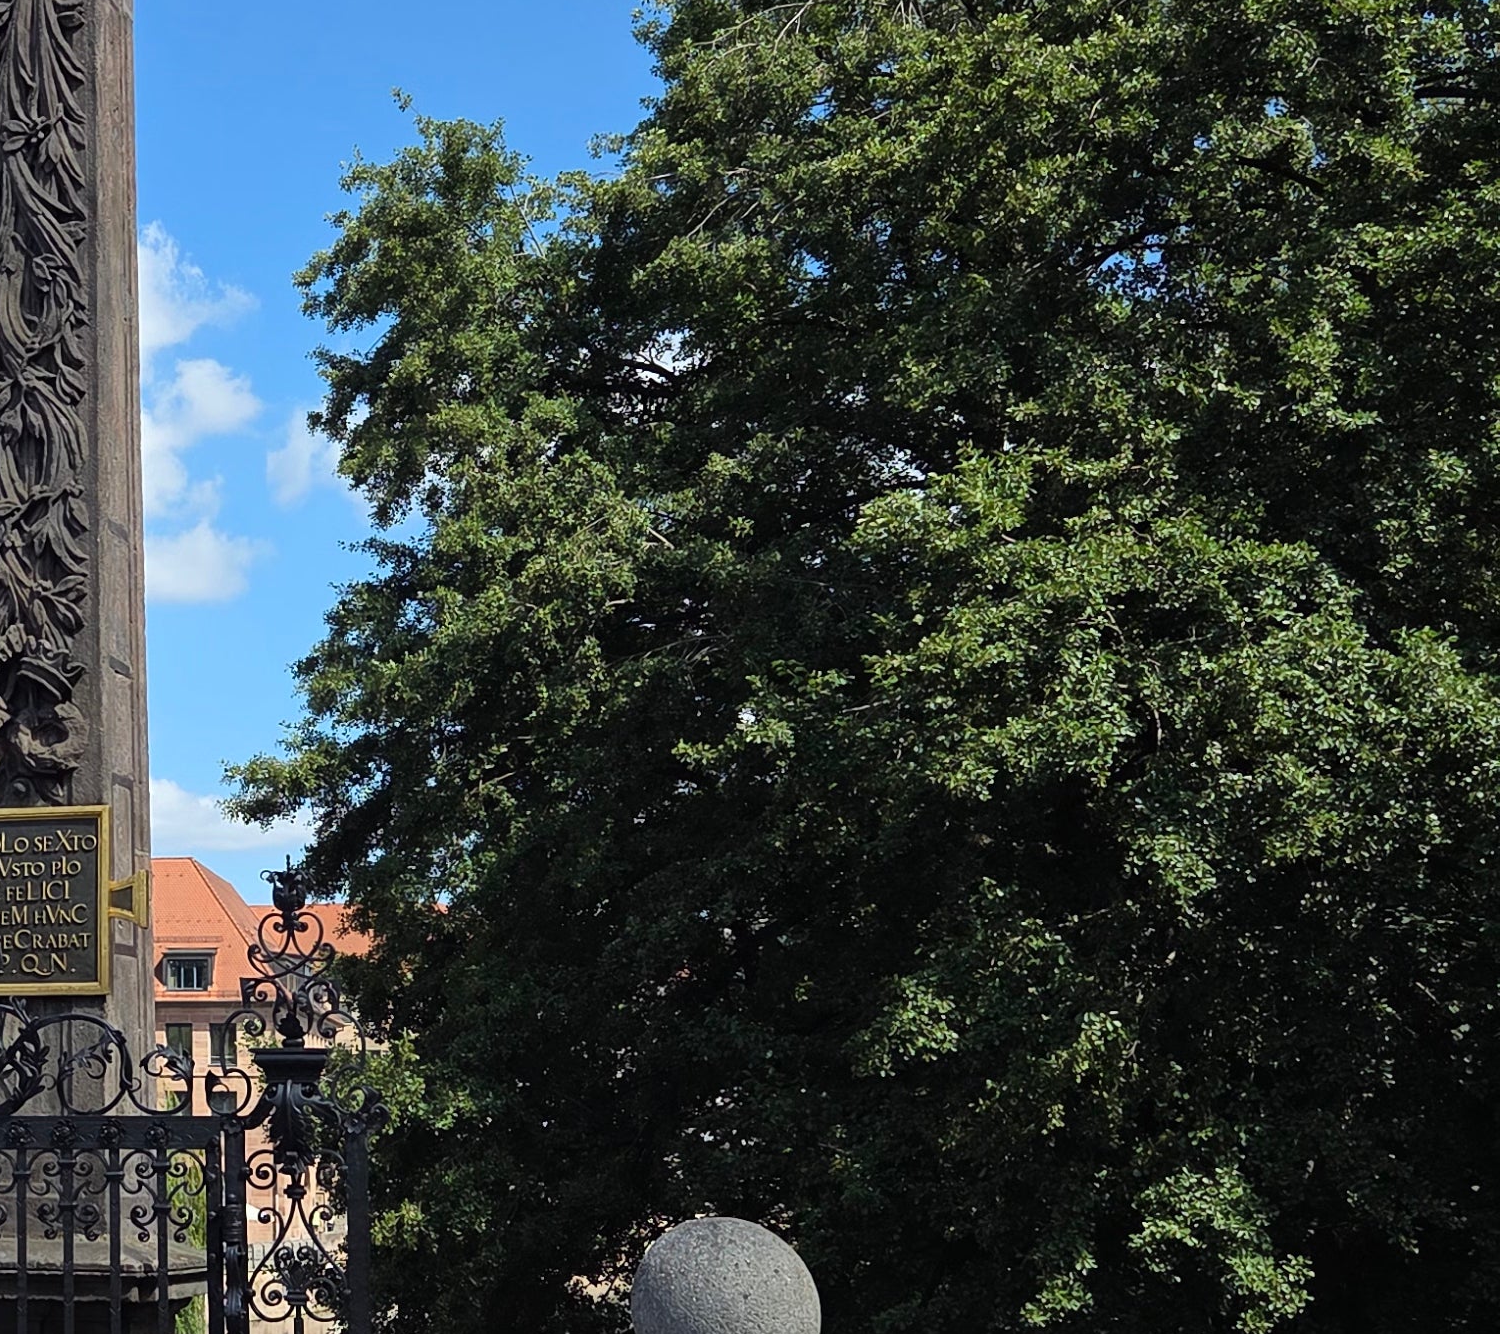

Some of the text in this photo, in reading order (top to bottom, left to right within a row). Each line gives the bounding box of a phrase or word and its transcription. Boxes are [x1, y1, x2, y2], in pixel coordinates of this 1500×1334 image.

[34, 829, 98, 853] SEXTO
[52, 856, 82, 876] PIO
[6, 880, 70, 902] FELICI
[35, 904, 88, 925] HVNC
